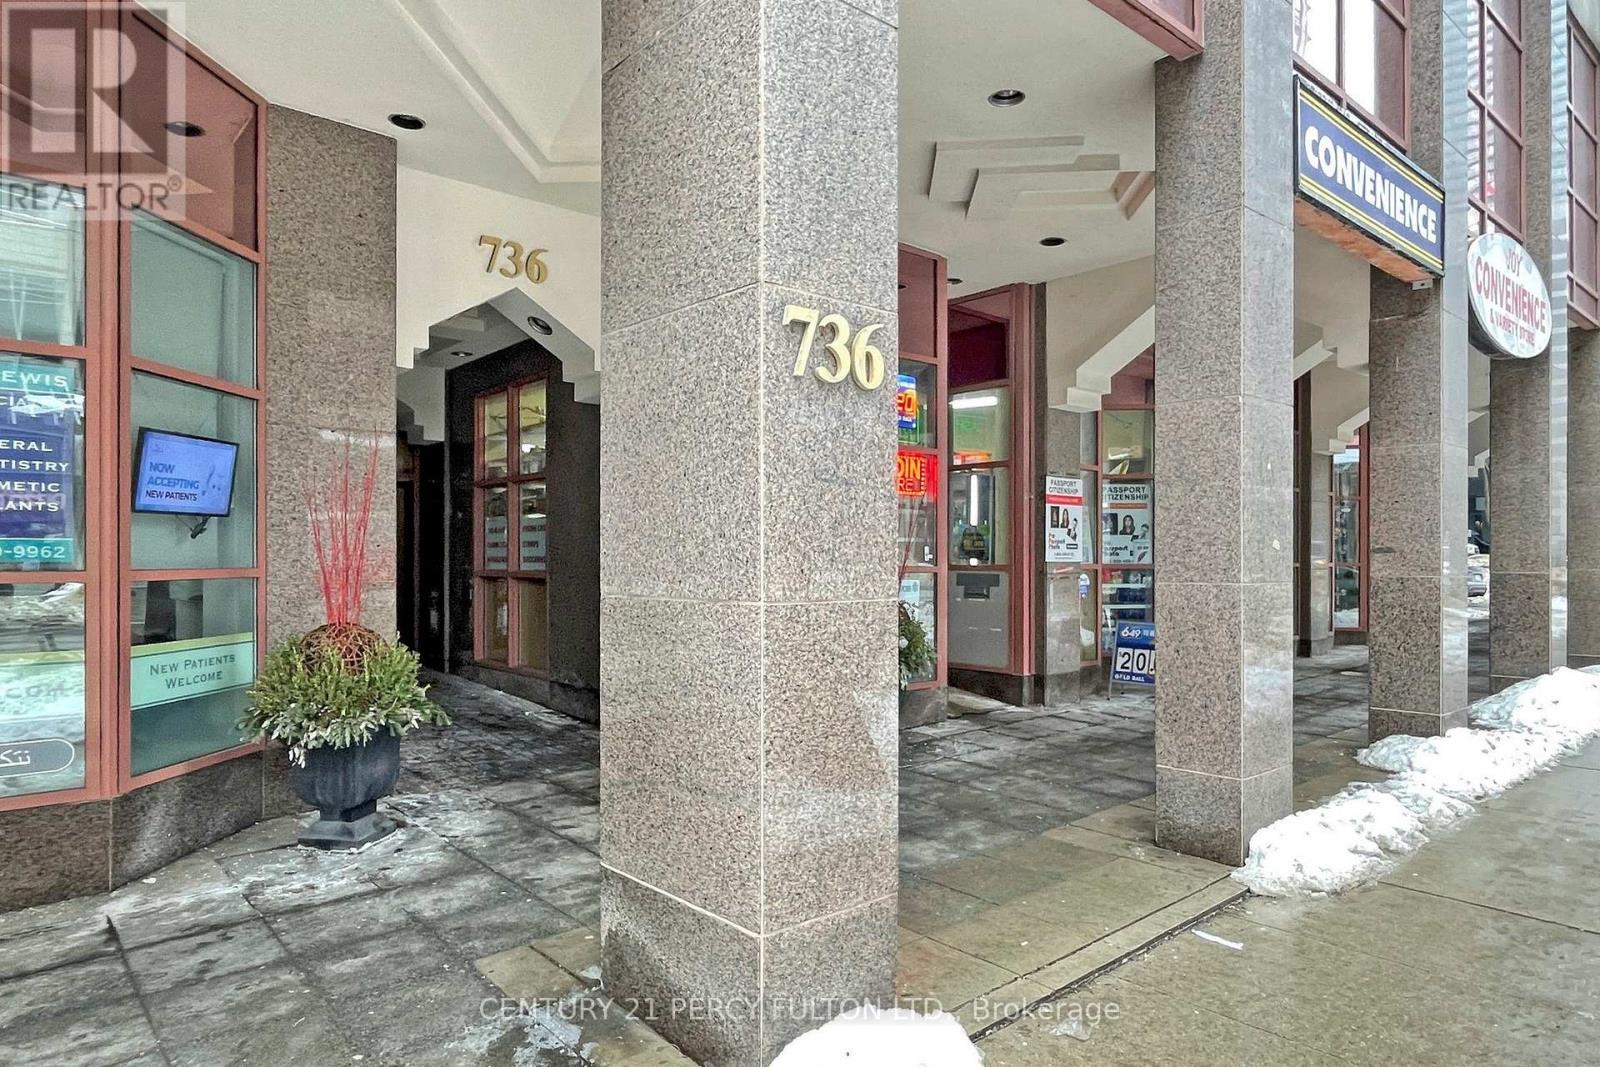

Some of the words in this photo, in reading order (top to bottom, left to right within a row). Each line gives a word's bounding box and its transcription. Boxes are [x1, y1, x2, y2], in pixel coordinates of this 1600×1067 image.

[1304, 125, 1437, 244] CONVENIENCE
[478, 234, 549, 284] 736
[1475, 255, 1546, 334] CONVENIENCE
[781, 304, 886, 392] 736
[149, 462, 176, 474] NOW
[147, 475, 200, 490] ACCEPTING
[1050, 479, 1077, 488] PASSPORT
[145, 489, 164, 499] NEW
[165, 491, 198, 501] PATIENTS
[0, 500, 59, 512] ANTS
[0, 544, 66, 559] -9962
